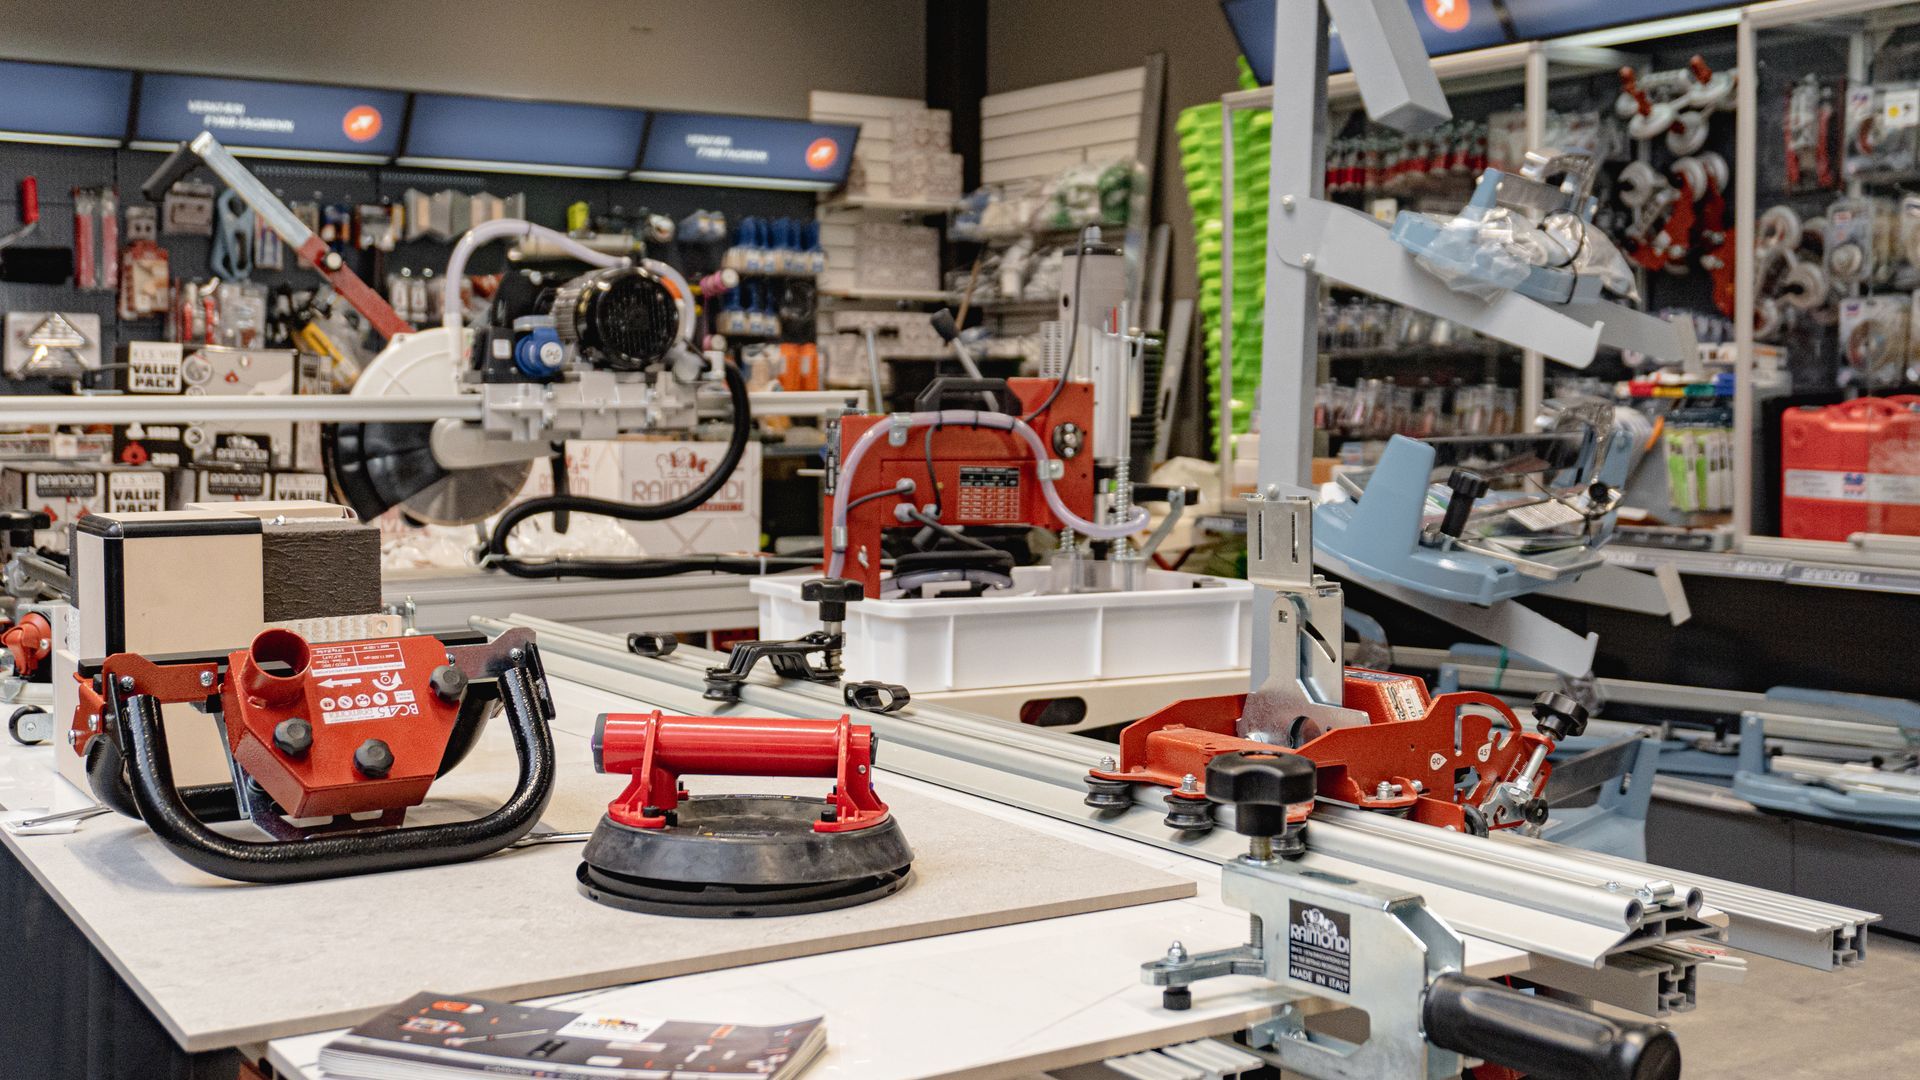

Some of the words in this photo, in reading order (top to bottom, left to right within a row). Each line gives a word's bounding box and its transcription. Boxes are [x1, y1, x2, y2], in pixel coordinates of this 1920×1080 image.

[132, 364, 179, 375] VALUE
[134, 378, 176, 389] PACK
[113, 488, 161, 500] VALUE
[278, 490, 323, 500] VALUE
[630, 479, 745, 501] RAIMNDI
[116, 502, 159, 512] PACK
[1290, 923, 1350, 954] RAIMONDI
[1290, 966, 1313, 982] MADE
[1315, 973, 1326, 985] IN
[1328, 977, 1350, 992] ITALY
